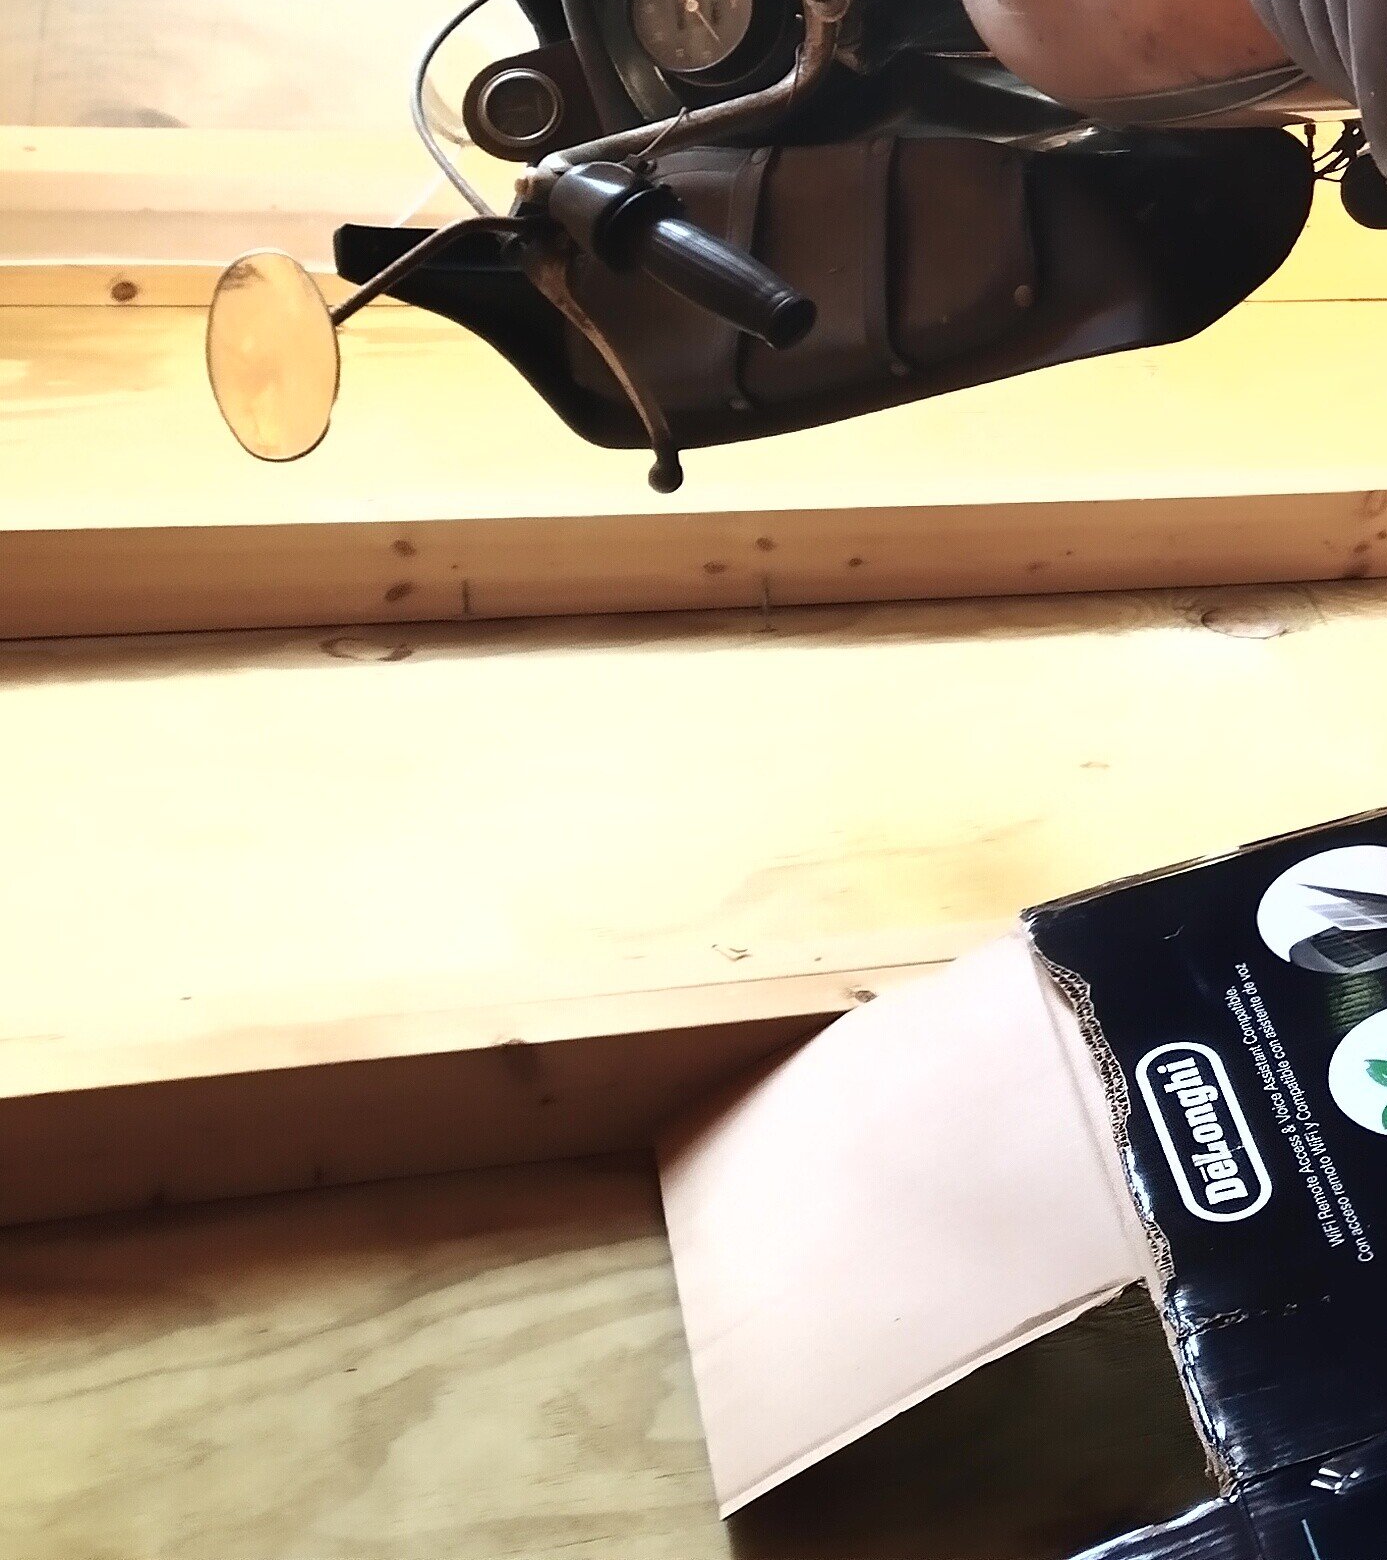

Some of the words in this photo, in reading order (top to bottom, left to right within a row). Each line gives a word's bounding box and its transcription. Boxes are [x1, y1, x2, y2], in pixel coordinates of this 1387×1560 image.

[1235, 962, 1251, 982] voz
[1241, 981, 1258, 995] de
[1225, 986, 1258, 1045] Compatible.
[1250, 996, 1277, 1039] asistente
[1268, 1039, 1286, 1060] con
[1249, 1044, 1279, 1091] Assistant
[1276, 1060, 1311, 1121] Compatible
[1270, 1092, 1291, 1124] Voice
[1281, 1124, 1297, 1134] &
[1303, 1122, 1320, 1131] y
[1288, 1134, 1314, 1173] Access
[1303, 1130, 1327, 1156] WiFi
[1319, 1156, 1345, 1195] remoto
[1306, 1175, 1334, 1220] Remote
[1337, 1196, 1363, 1236] acceso
[1321, 1220, 1345, 1247] WiFi
[1355, 1236, 1374, 1262] Con
